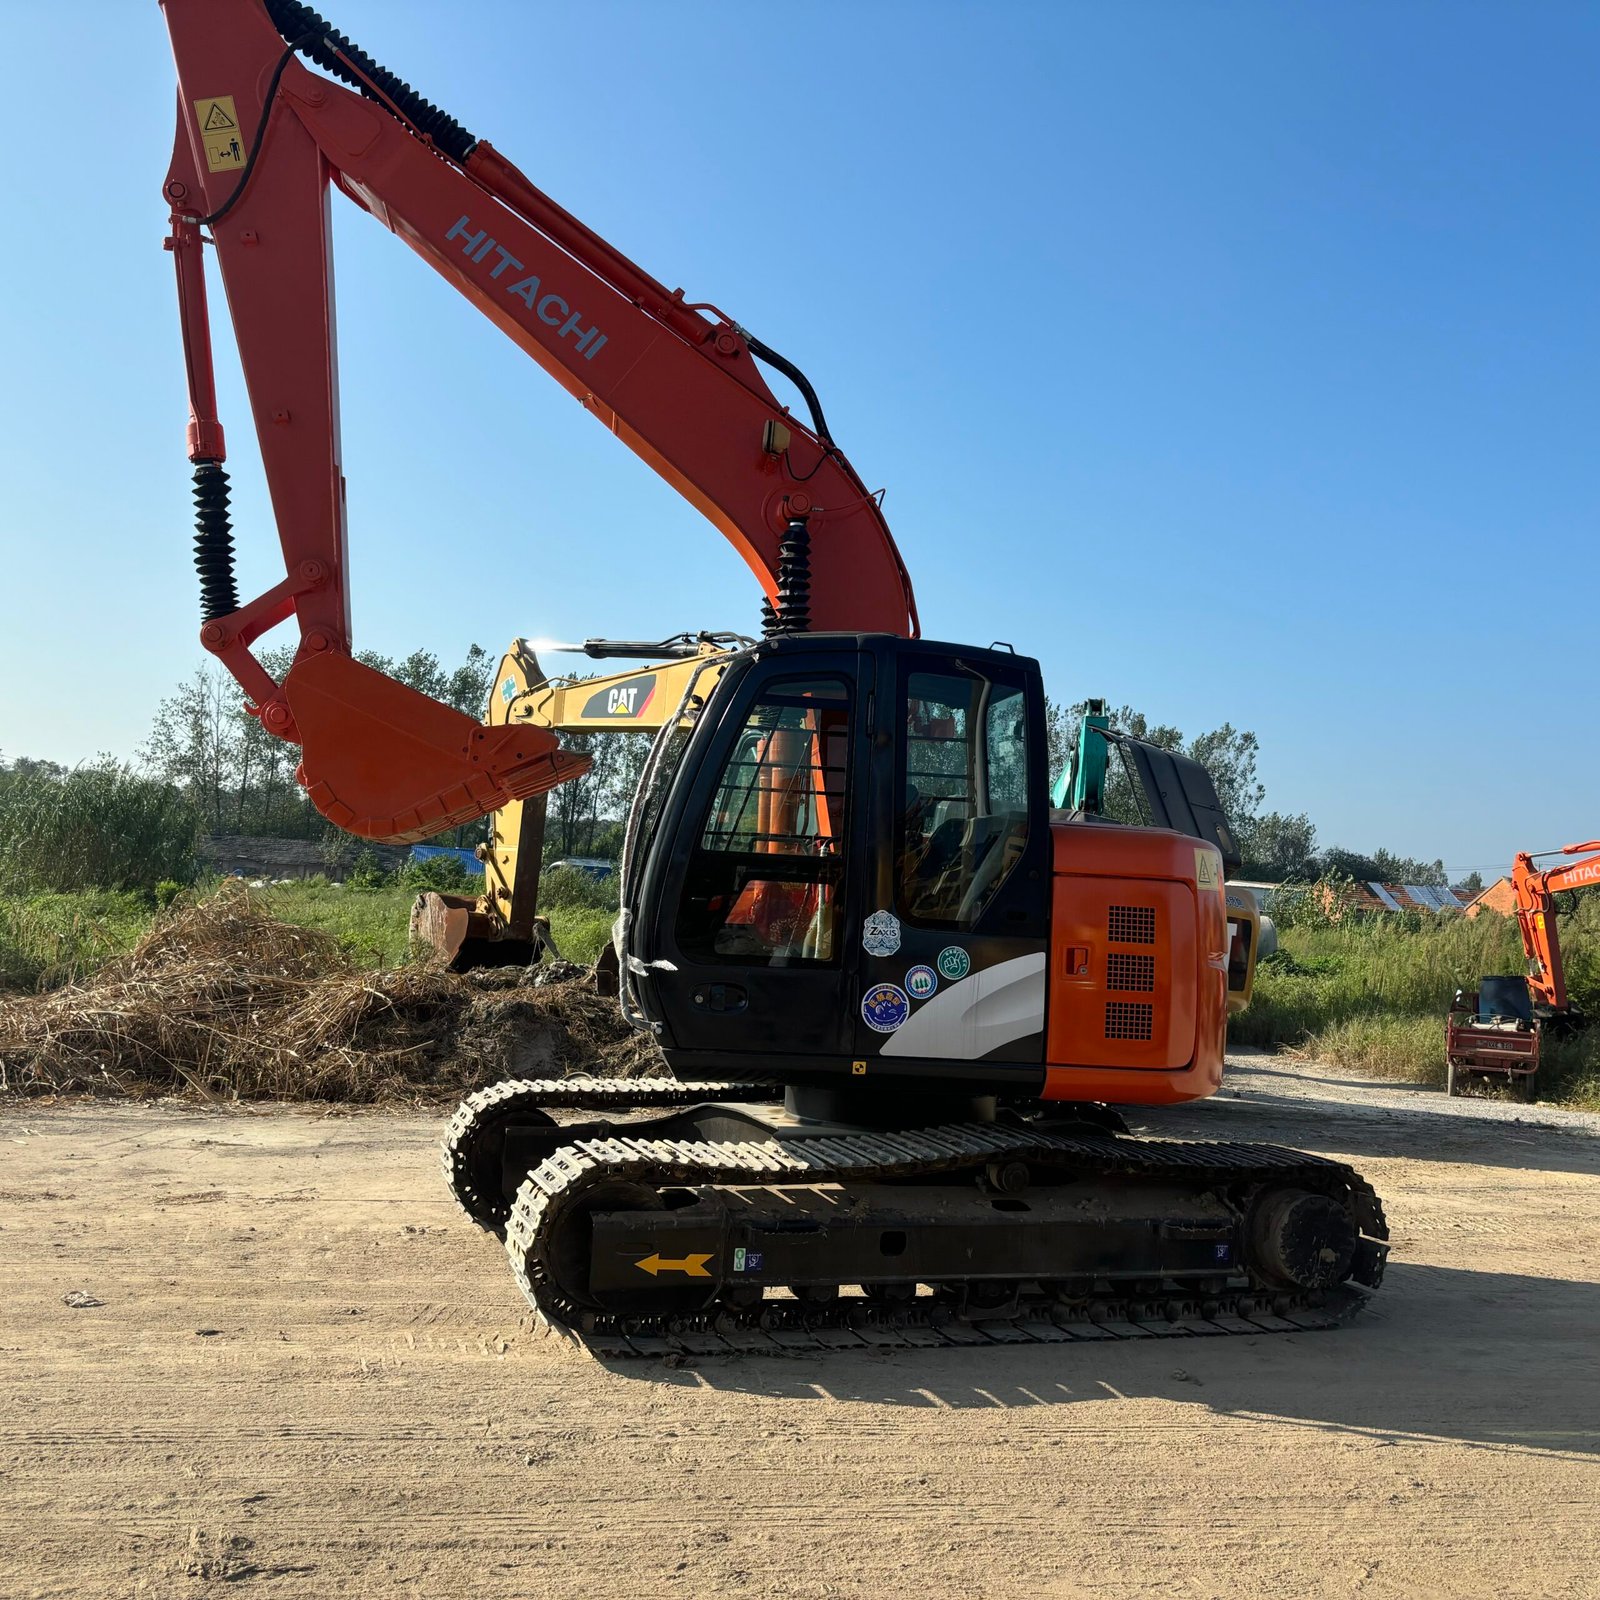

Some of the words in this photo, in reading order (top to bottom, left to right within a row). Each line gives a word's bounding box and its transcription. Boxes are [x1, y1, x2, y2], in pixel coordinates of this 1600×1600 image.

[445, 215, 608, 360] HITACHI
[607, 688, 638, 714] CAT
[869, 926, 897, 937] ZAXIS
